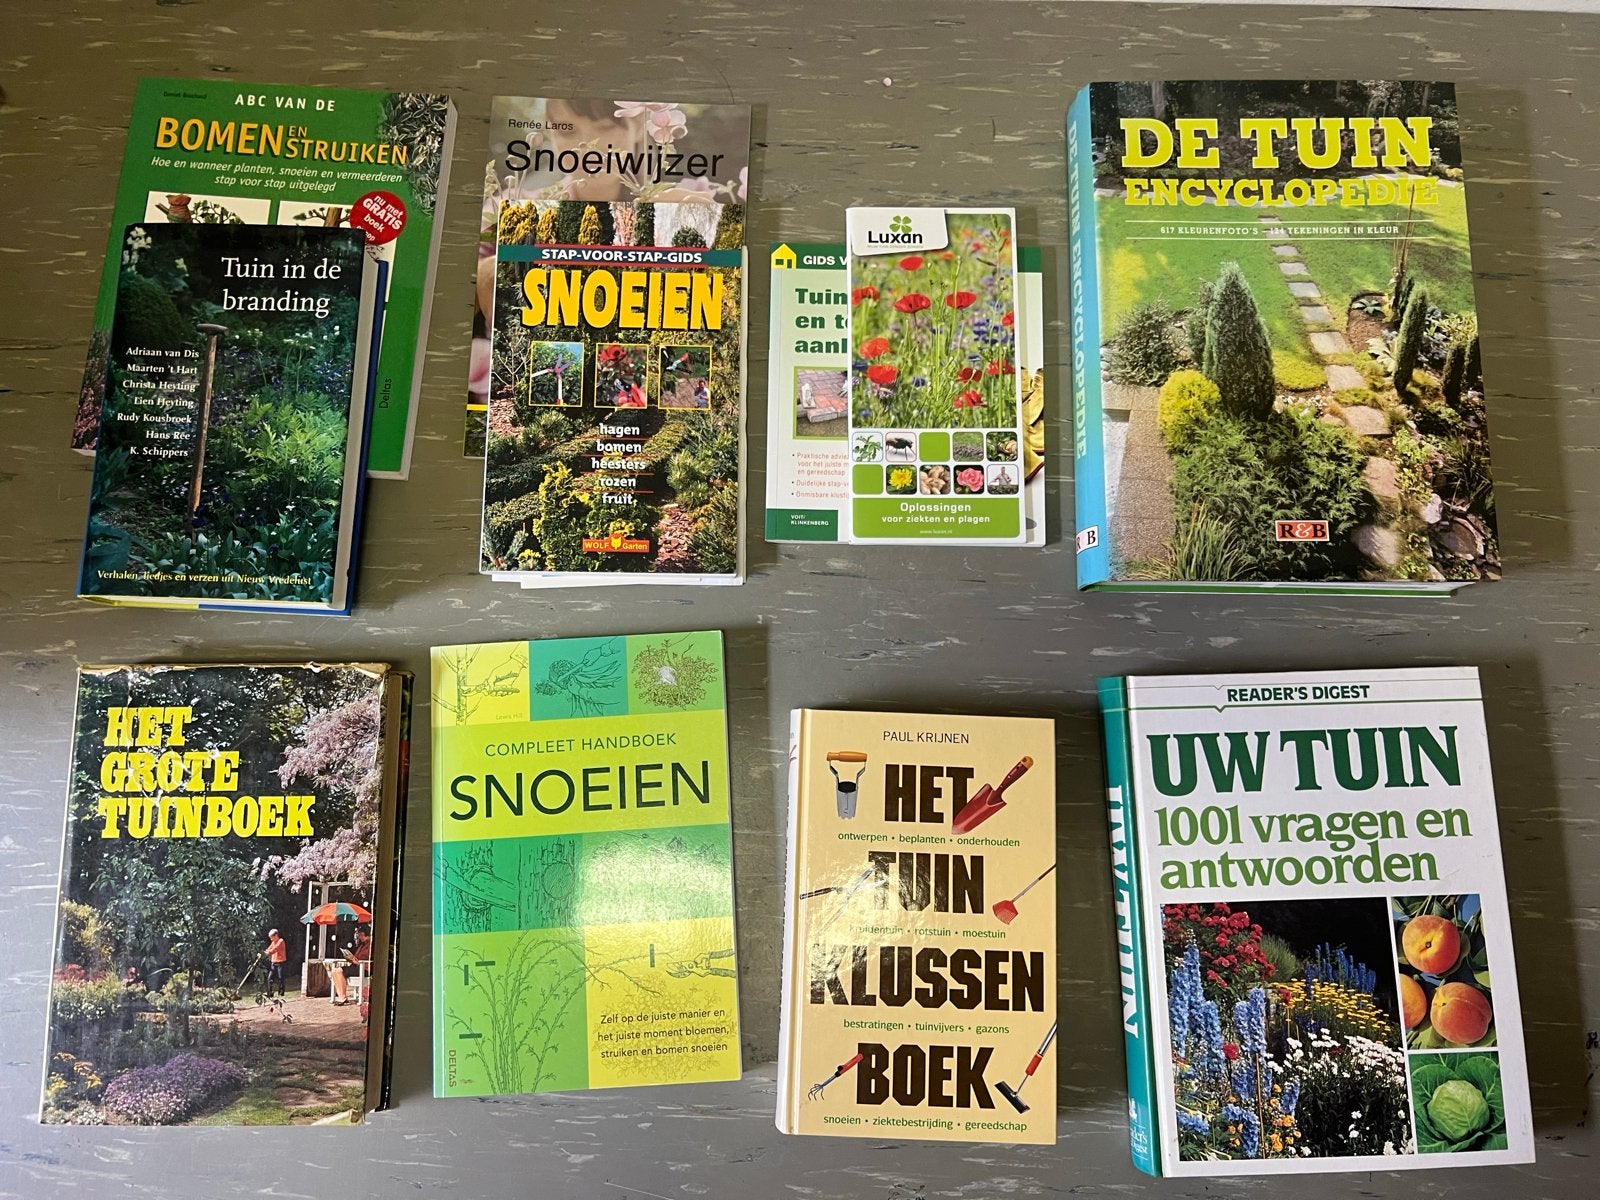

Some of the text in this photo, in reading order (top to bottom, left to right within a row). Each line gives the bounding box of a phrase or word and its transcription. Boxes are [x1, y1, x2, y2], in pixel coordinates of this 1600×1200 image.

[235, 94, 335, 112] ABC VAN DE
[508, 118, 574, 131] Renée Laros
[156, 117, 308, 156] BOMEN EN
[1120, 116, 1433, 169] DE TUIN
[285, 138, 408, 165] STRUIKEN
[151, 156, 403, 183] Hoe en wanneer planten, snoeien en vermeerderen
[505, 140, 725, 184] Snoeiwijzer
[214, 175, 336, 193] stap voor stap uitgelegd
[1123, 177, 1439, 207] ENCYCLOPEDIE
[362, 198, 402, 230] GRATIS
[374, 195, 403, 219] nu met
[363, 213, 385, 232] boek
[1160, 226, 1175, 234] 617
[1178, 226, 1259, 235] KLEURENFOTO'S
[1287, 226, 1350, 235] TEKENINGEN
[1353, 226, 1364, 234] IN
[1367, 226, 1399, 234] KLEUR
[868, 230, 923, 244] Luxan
[541, 249, 702, 264] STAP-VOOR-STAP-GIDS
[803, 255, 836, 266] GIDS
[221, 256, 342, 281] Tuin in de
[521, 267, 724, 330] SNOEIEN
[795, 288, 848, 305] Tuin
[1068, 120, 1087, 460] DE TUIN ENCYCLOPEDIE
[222, 289, 331, 319] branding
[795, 315, 826, 329] en
[125, 346, 162, 357] Adriaan
[184, 349, 200, 358] Dis
[126, 363, 165, 373] Maarten
[176, 366, 197, 375] Hart
[122, 380, 196, 393] Christa Heyting
[133, 396, 194, 410] Lien Heyting
[116, 412, 192, 424] Rudy Kousbroek
[145, 430, 171, 439] Hans
[599, 424, 640, 438] hagen
[130, 446, 189, 459] K. Schippers
[596, 441, 642, 454] bomen
[591, 457, 646, 471] heesters
[599, 476, 637, 488] rozen
[900, 502, 972, 514] Oplossingen
[882, 515, 903, 523] voor
[906, 514, 941, 523] ziekten
[958, 515, 991, 525] plagen
[1278, 522, 1329, 540] R&B
[622, 542, 648, 550] Garten
[97, 569, 140, 580] Verhalen,
[143, 571, 173, 582] liedjes
[174, 573, 187, 581] en
[188, 574, 219, 582] verzen
[221, 574, 234, 583] uit
[236, 574, 266, 584] Nieuw
[1227, 684, 1370, 702] READER'S DIGEST
[103, 706, 192, 747] HET
[485, 733, 677, 757] COMPLEET HANDBOEK
[883, 730, 970, 744] PAUL KRIJNEN
[1146, 725, 1462, 797] UW TUIN
[100, 751, 240, 792] GROTE
[449, 760, 710, 822] SNOEIEN
[884, 763, 975, 824] HET
[98, 795, 316, 839] TUINBOEK
[1154, 804, 1472, 852] 1001 vragen en
[837, 832, 1020, 847] ontwerpen beplanten onderhouden
[1160, 841, 1440, 890] antwoorden
[868, 850, 985, 915] TUIN
[914, 927, 951, 937] rotstuin
[962, 929, 1006, 939] moestuin
[810, 943, 1045, 1013] KLUSSEN
[600, 1008, 726, 1025] Zelf op de juiste manier en
[597, 1026, 730, 1042] het juiste moment bloemen,
[843, 1018, 1010, 1035] bestratingen tuinvijvers gazons
[600, 1042, 728, 1058] struiken en bomen snoeien
[448, 1049, 457, 1088] DELTAS
[856, 1042, 996, 1110] BOEK
[823, 1115, 1027, 1131] snoeien ziektebestrijding gereedschap
